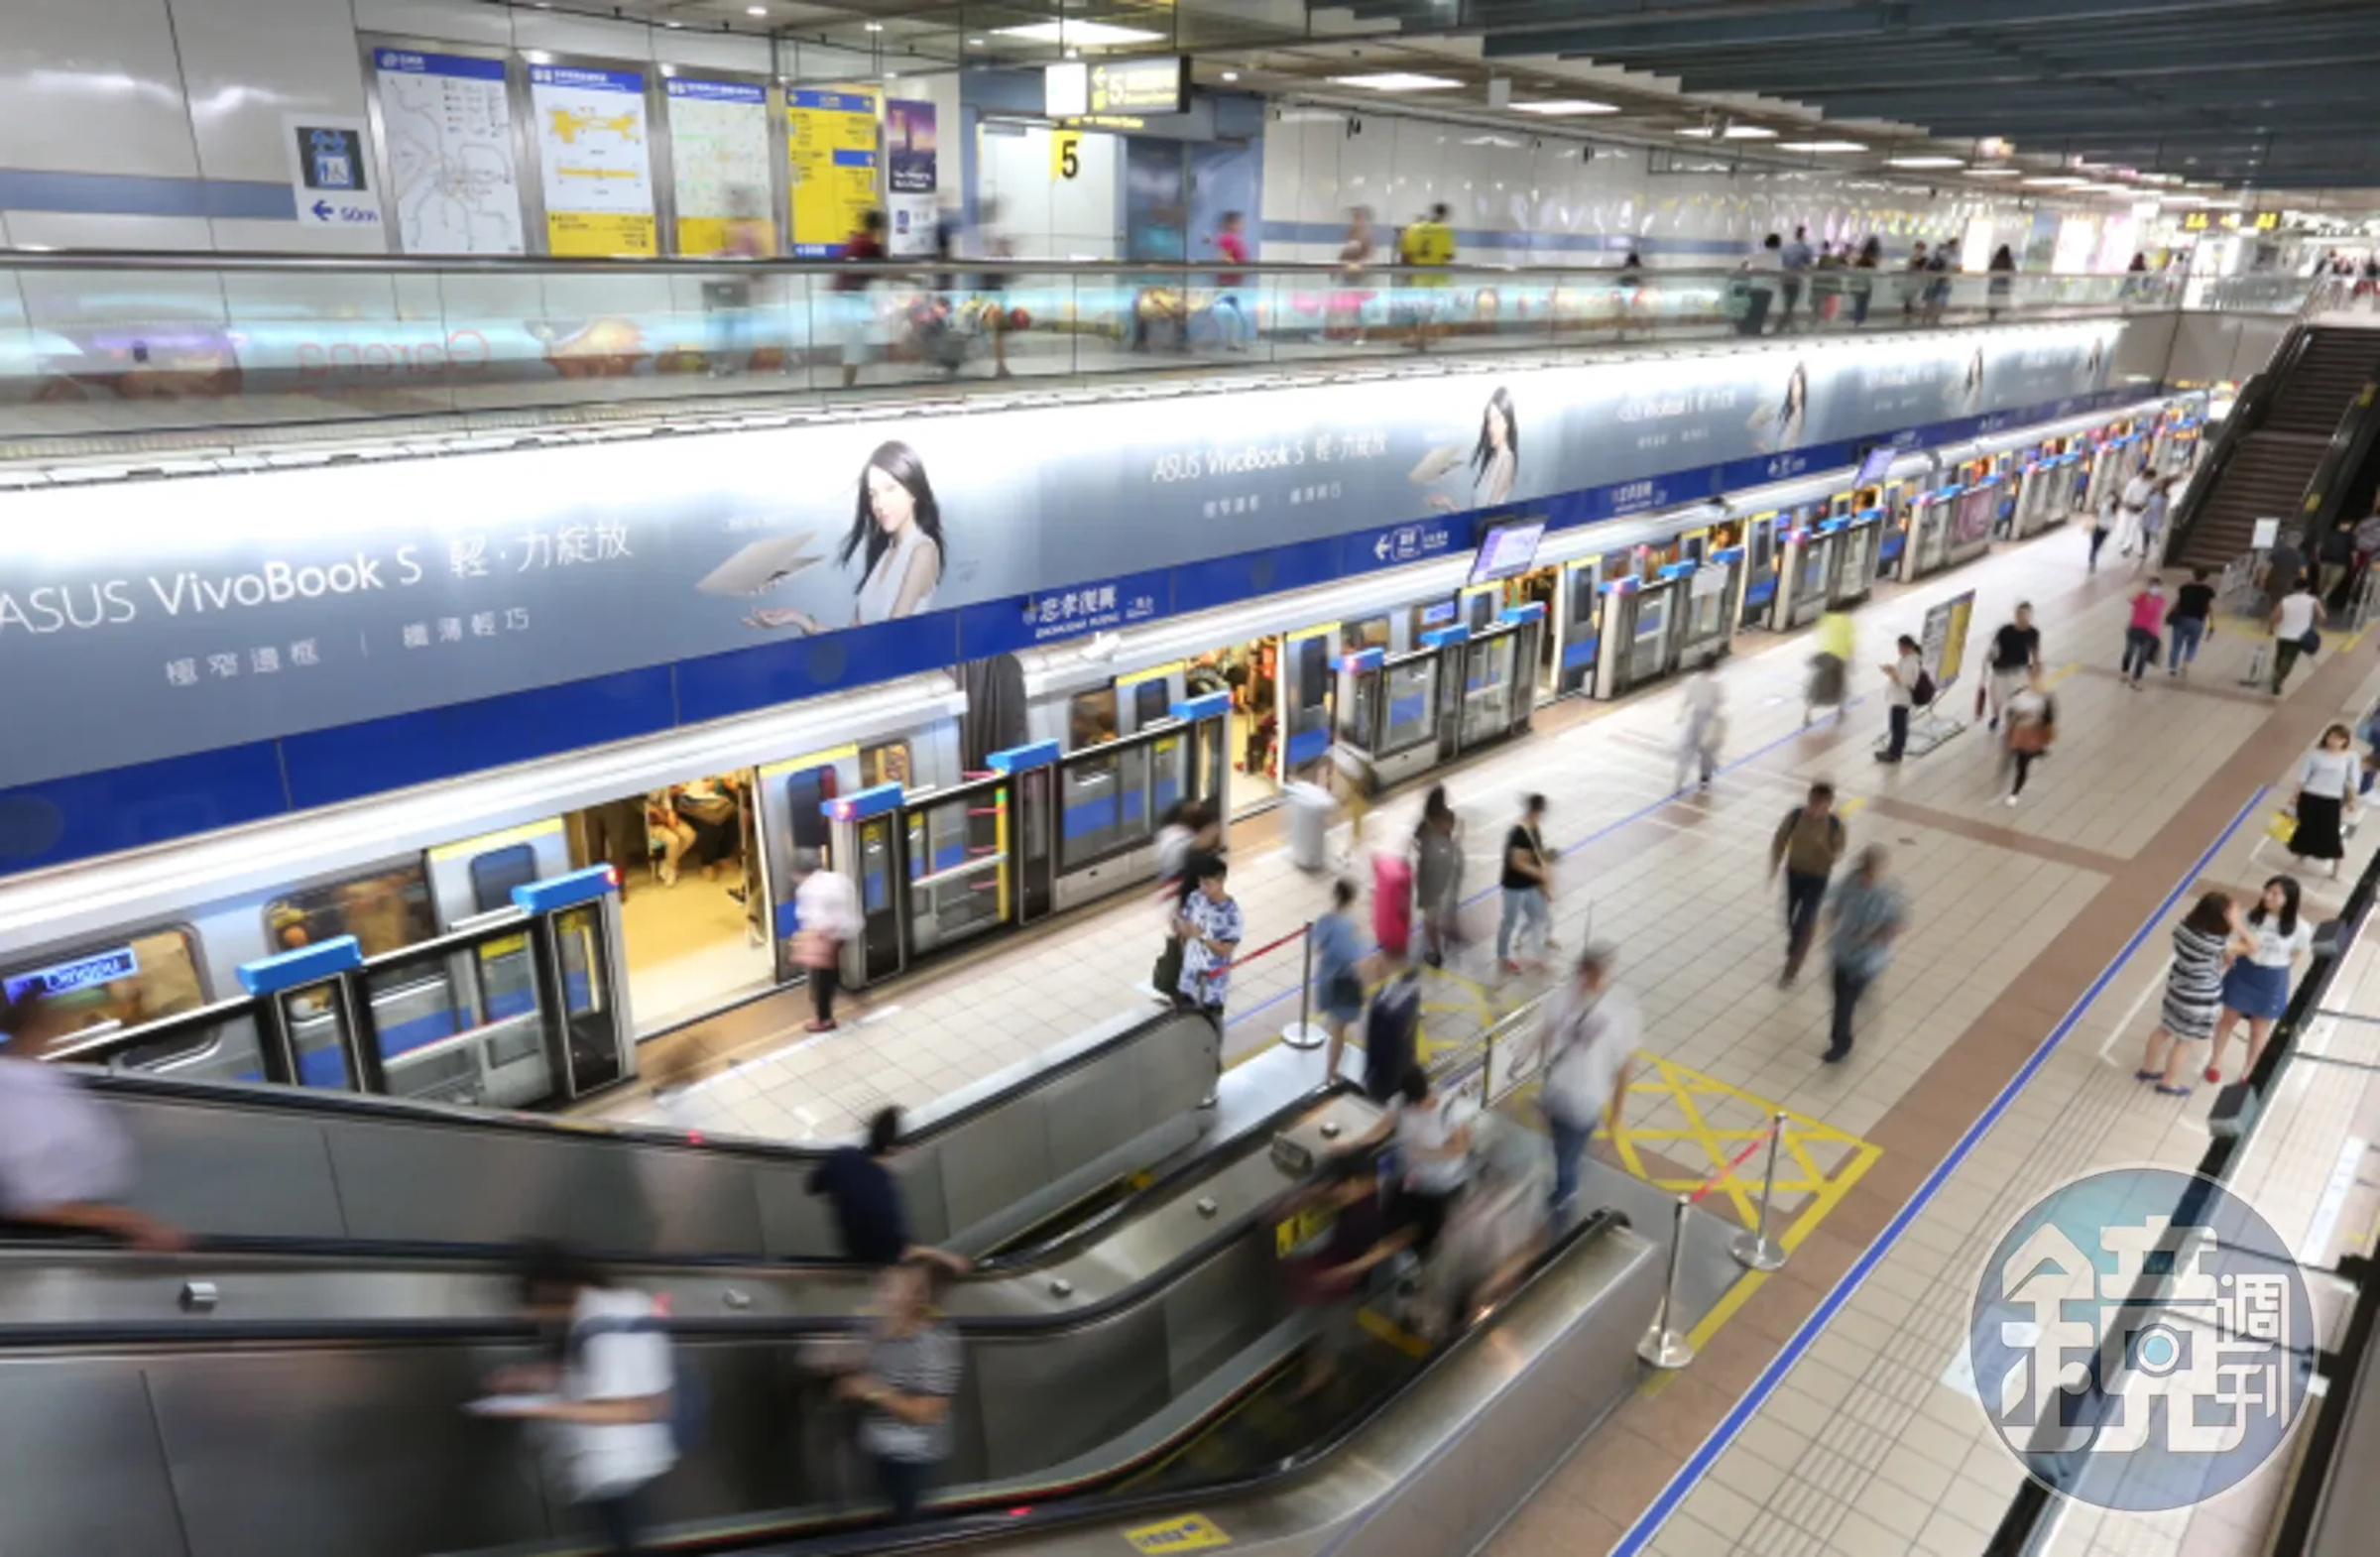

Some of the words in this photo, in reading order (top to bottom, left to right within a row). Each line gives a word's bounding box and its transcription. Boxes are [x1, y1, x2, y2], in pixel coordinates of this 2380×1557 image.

[1061, 140, 1078, 178] 5
[0, 579, 137, 635] ASUS
[149, 551, 384, 616] VivoBook
[397, 544, 422, 585] S
